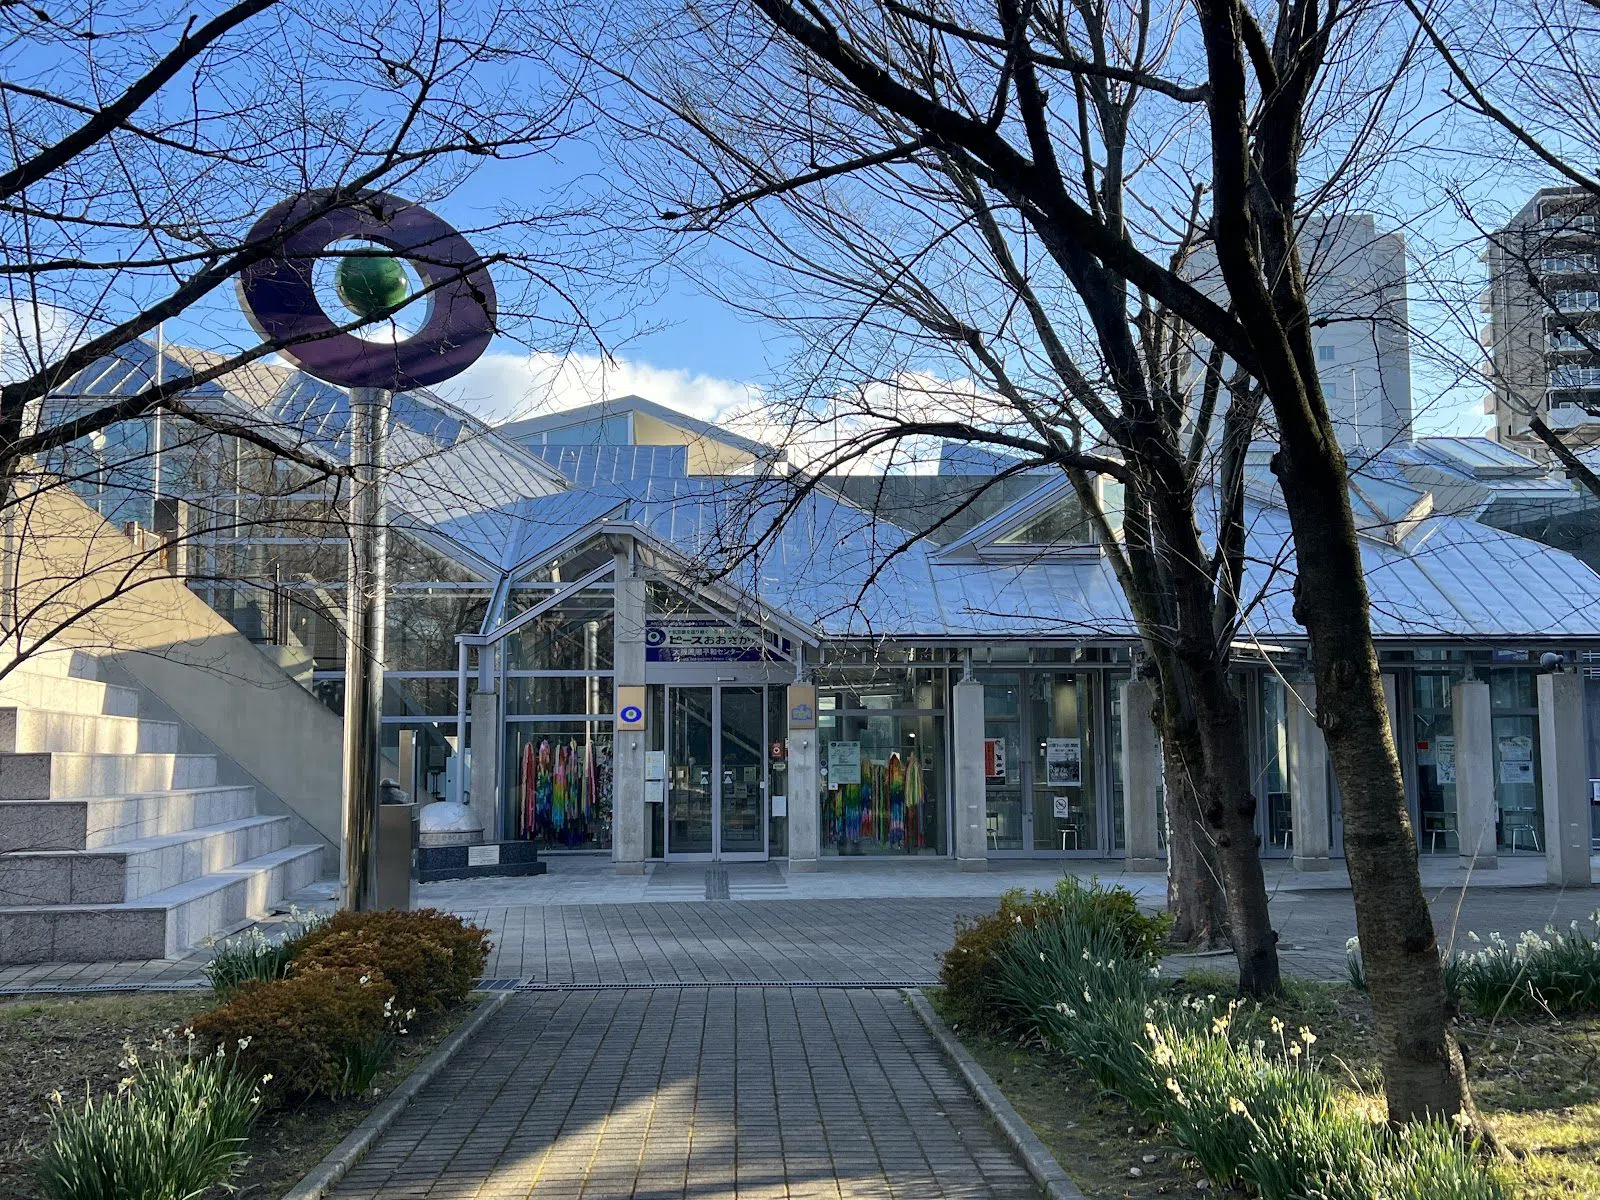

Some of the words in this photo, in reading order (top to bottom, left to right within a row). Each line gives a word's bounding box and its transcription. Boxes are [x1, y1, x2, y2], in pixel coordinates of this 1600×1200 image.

[669, 635, 750, 645] ピースおおさか
